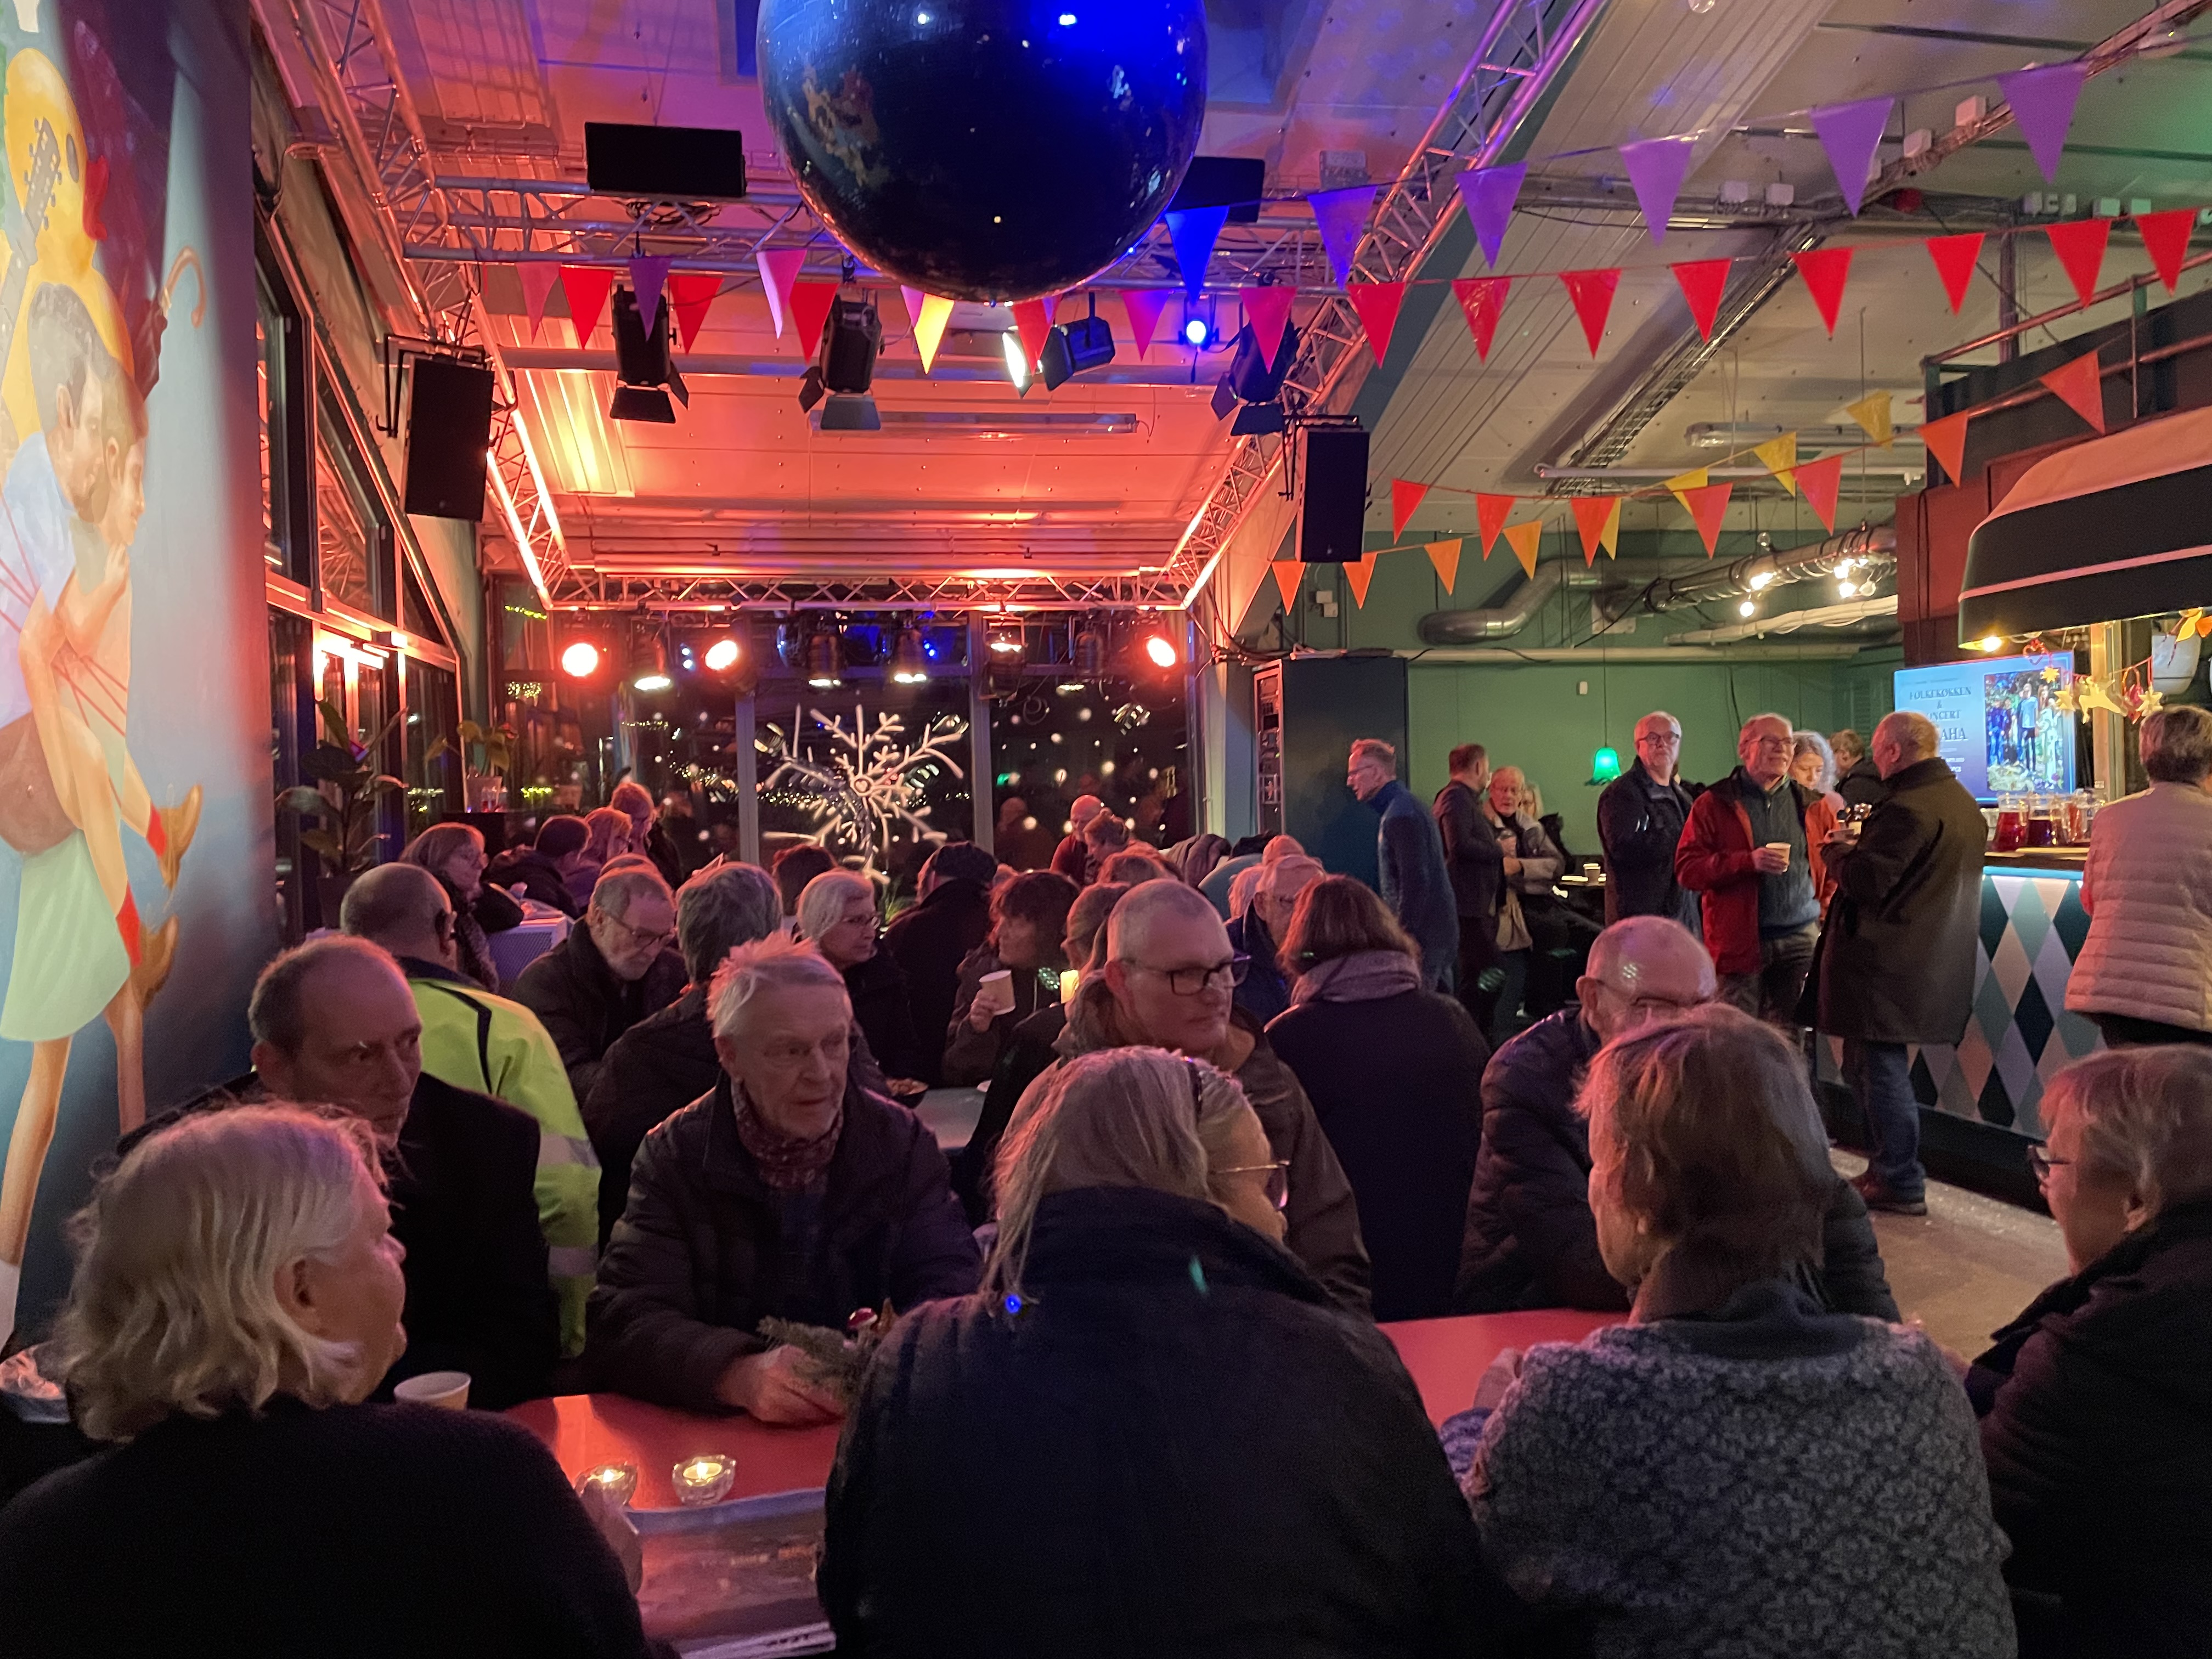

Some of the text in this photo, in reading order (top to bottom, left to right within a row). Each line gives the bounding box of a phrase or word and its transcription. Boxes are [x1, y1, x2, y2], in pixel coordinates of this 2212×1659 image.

[1937, 700, 1942, 709] &
[1926, 710, 1961, 720] ONCERT
[1941, 727, 1967, 741] AHA
